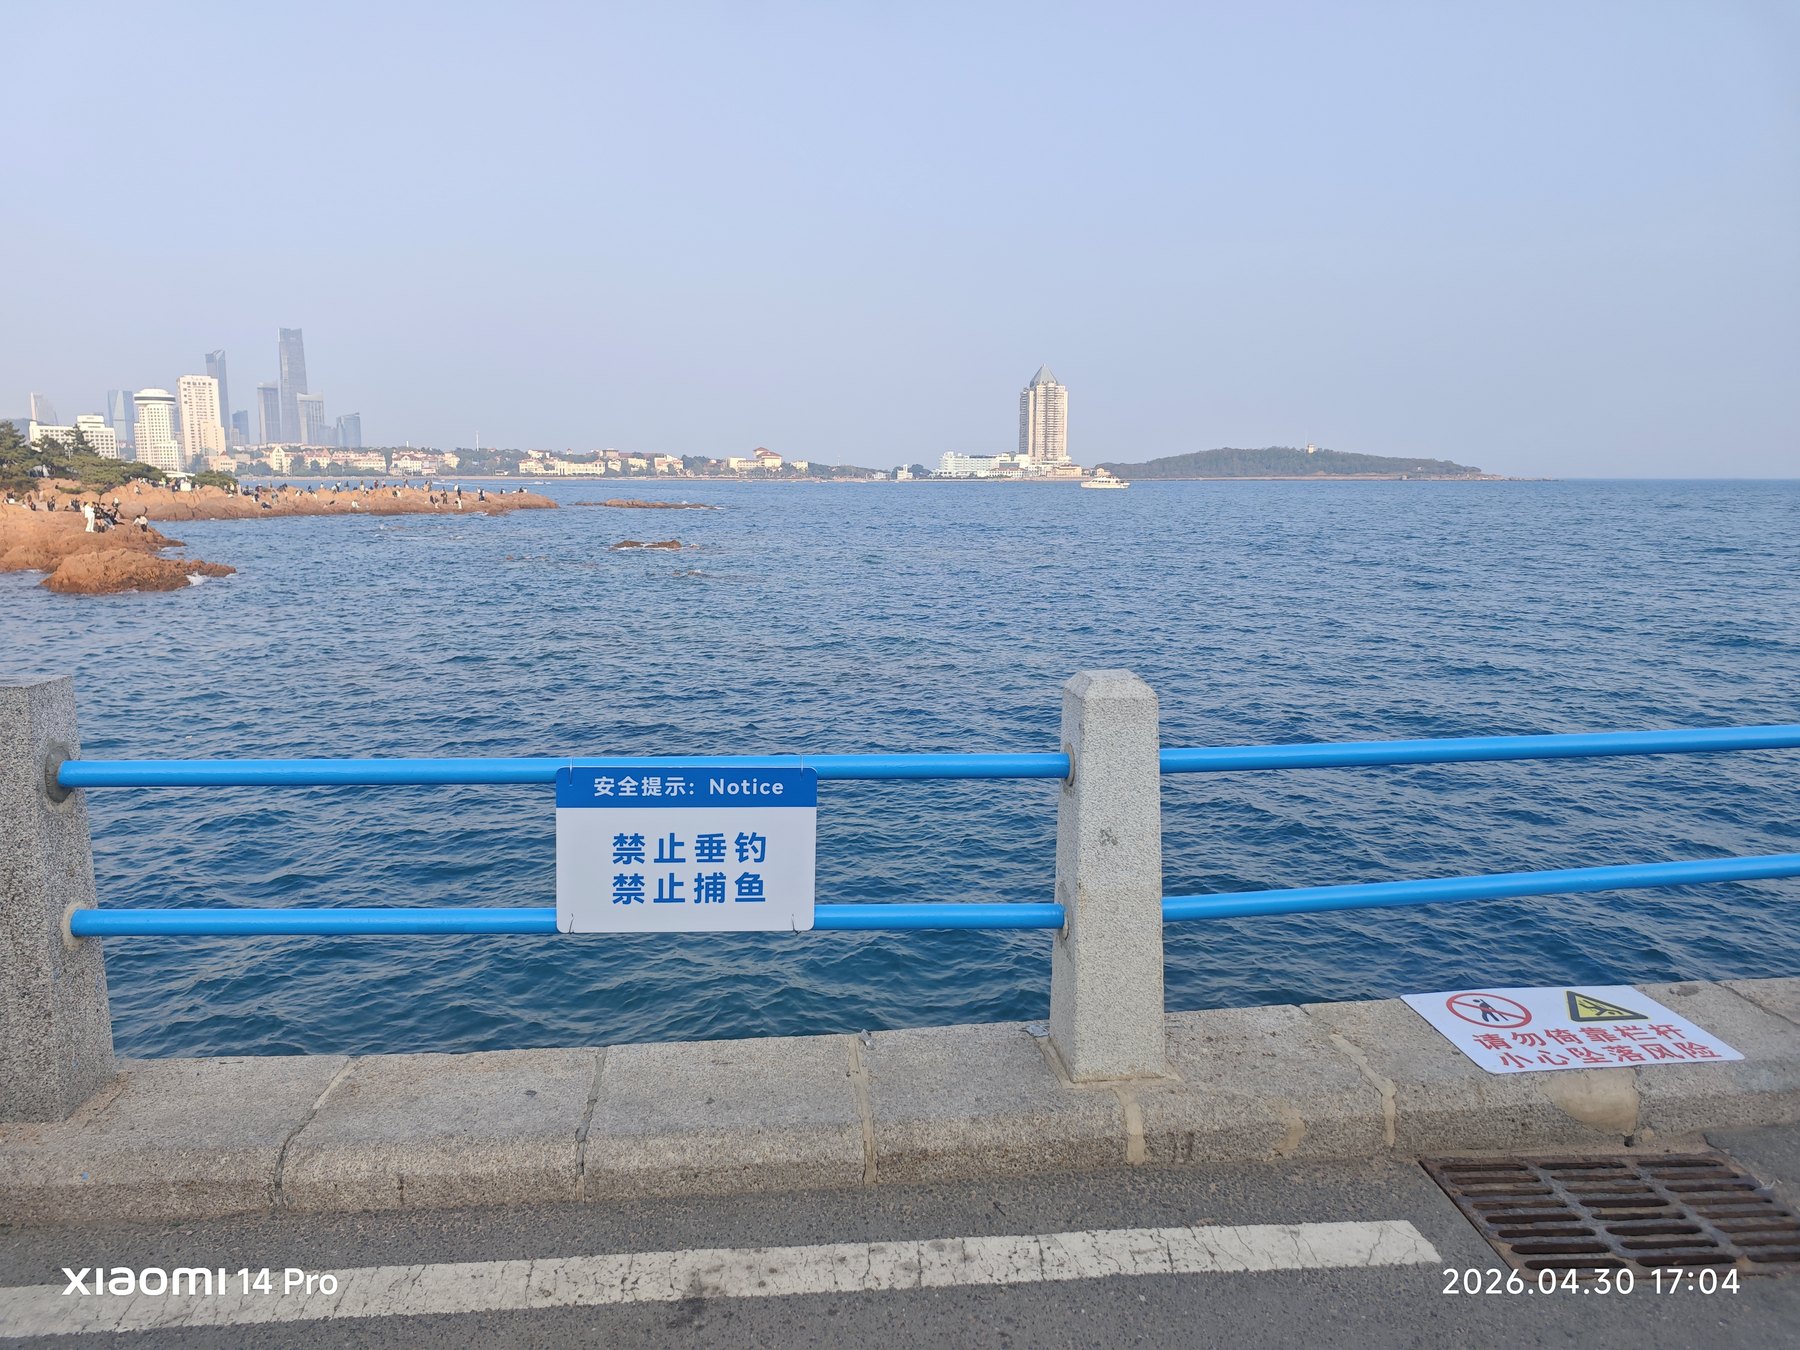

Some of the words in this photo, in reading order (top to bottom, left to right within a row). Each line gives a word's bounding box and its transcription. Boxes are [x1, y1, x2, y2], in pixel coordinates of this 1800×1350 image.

[709, 778, 784, 796] Notice
[612, 832, 767, 865] 禁止垂钓
[612, 871, 766, 905] 禁止捕鱼
[1473, 1023, 1689, 1051] 请勿倚靠栏杆
[1498, 1041, 1721, 1069] 小心坠落风险
